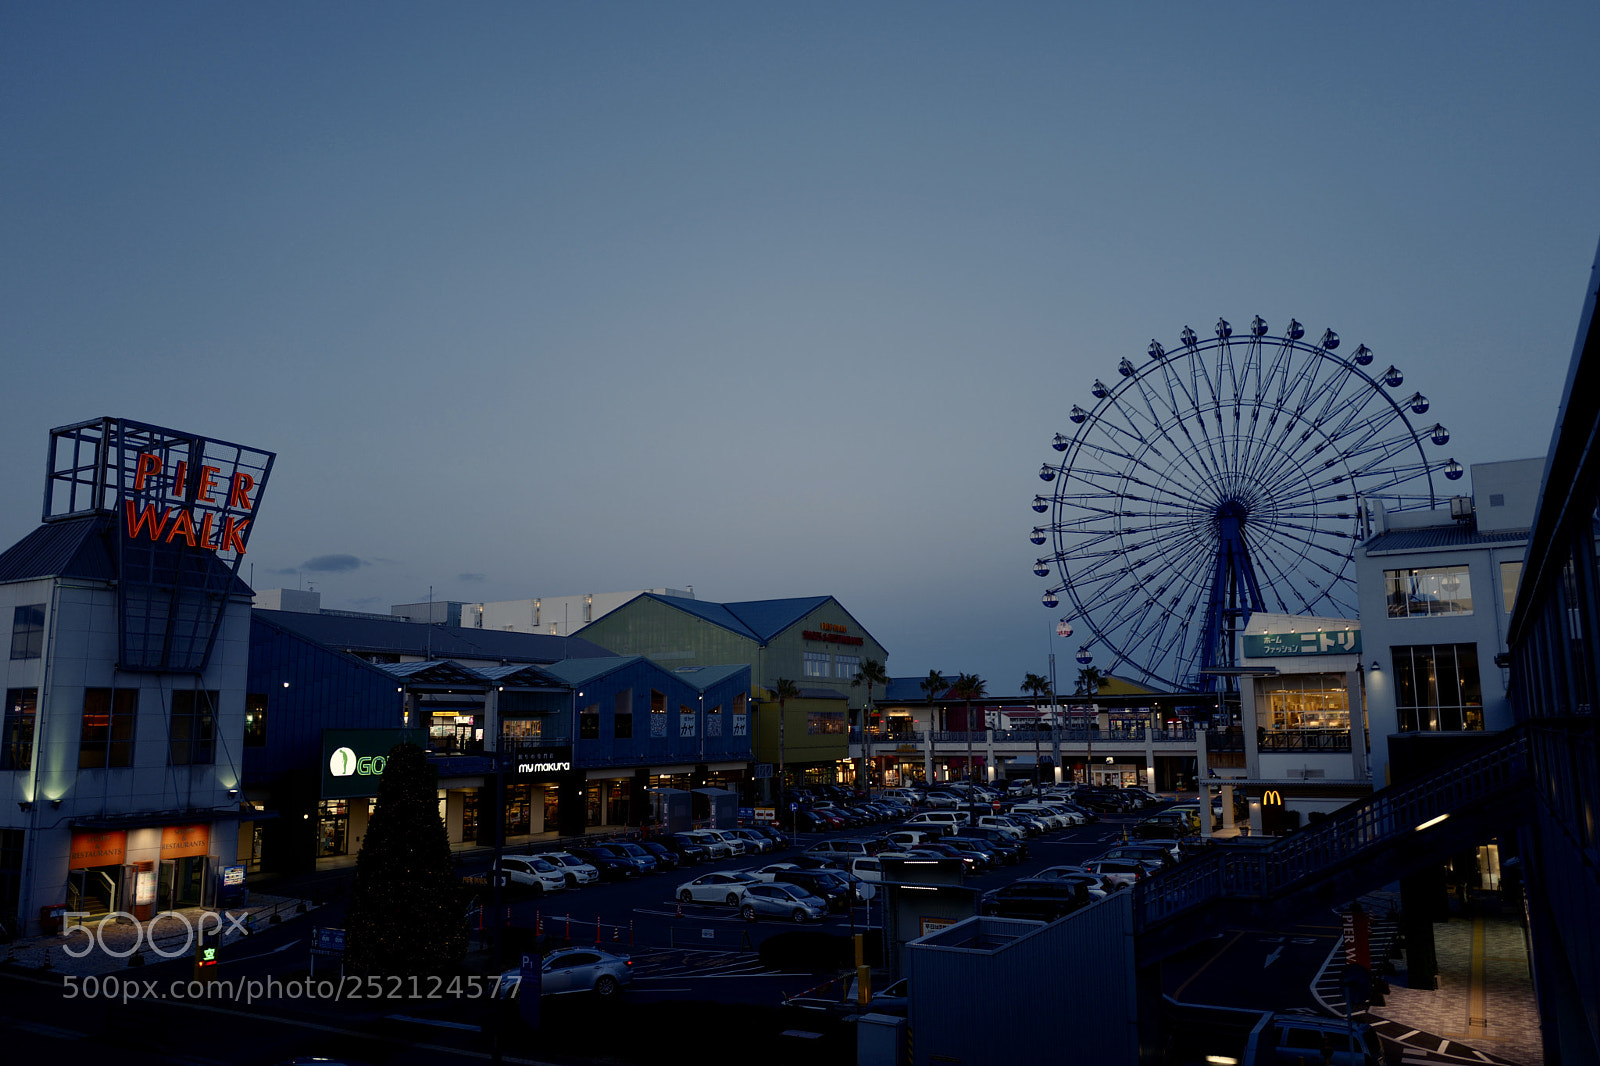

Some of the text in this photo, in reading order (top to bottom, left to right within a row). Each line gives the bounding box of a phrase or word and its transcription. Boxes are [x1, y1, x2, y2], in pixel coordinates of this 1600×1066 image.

[134, 453, 254, 509] PIER
[126, 500, 251, 554] WALK
[1263, 636, 1282, 645] ホーム
[1300, 631, 1355, 653] ニトリ
[1263, 645, 1299, 654] ファッション
[357, 755, 390, 776] GO
[518, 761, 570, 773] my makura
[161, 840, 206, 850] RESTAURANTS
[72, 848, 122, 860] RESTAURANTS
[1342, 914, 1355, 944] PIER
